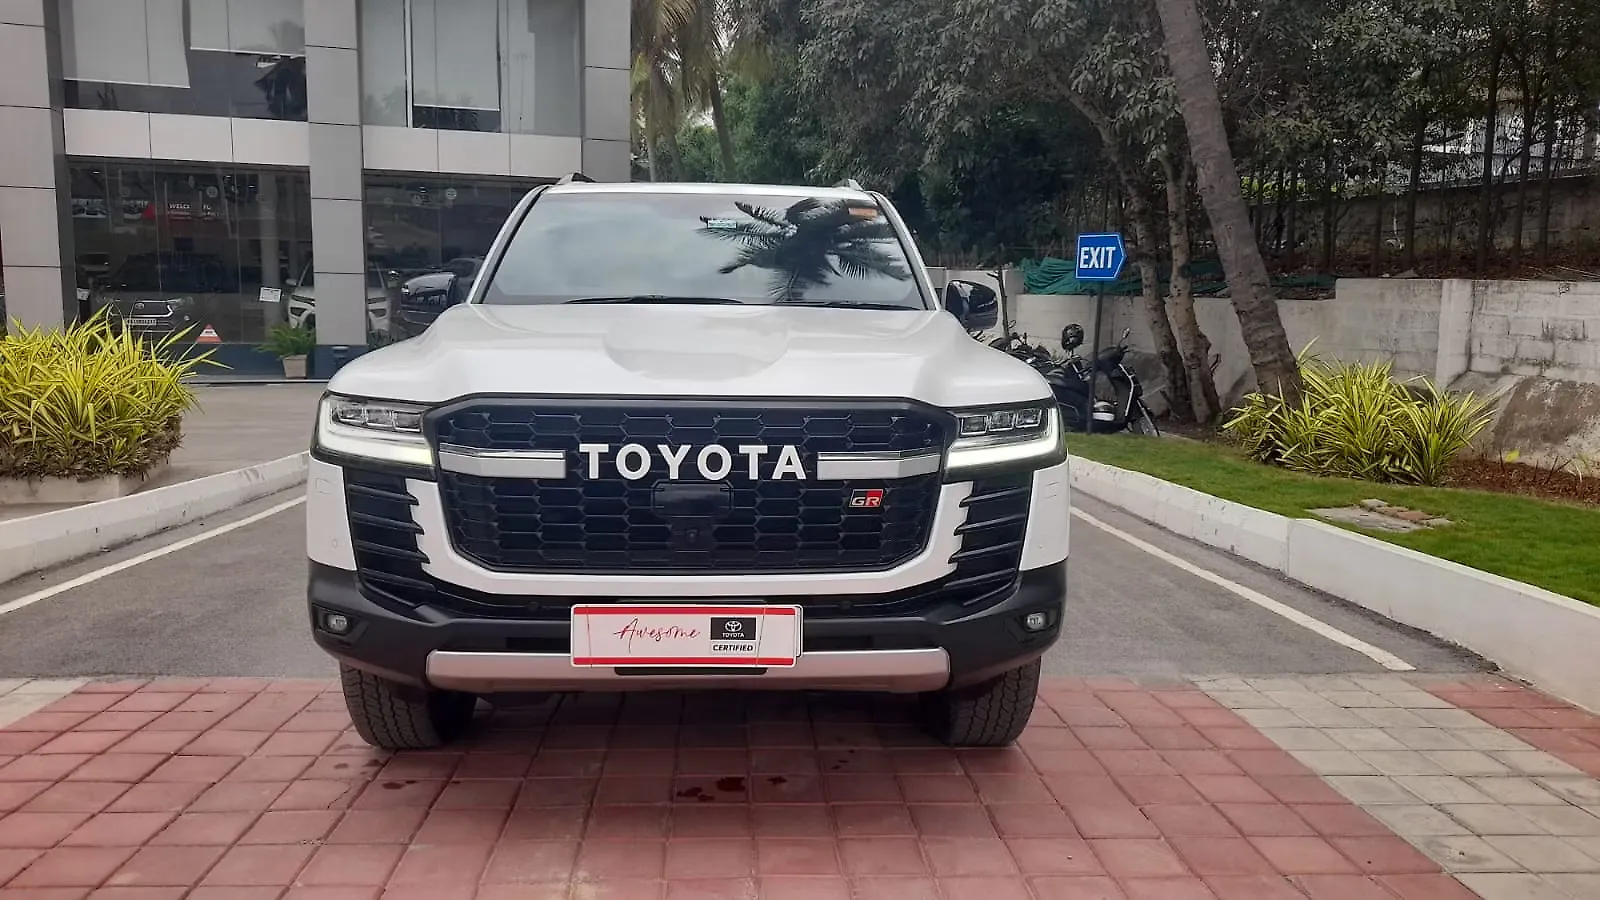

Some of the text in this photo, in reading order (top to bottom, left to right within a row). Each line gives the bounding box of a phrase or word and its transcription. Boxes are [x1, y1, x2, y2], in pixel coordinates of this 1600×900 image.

[1080, 246, 1116, 269] EXIT
[579, 443, 807, 480] TOYOTA
[852, 496, 880, 506] GR
[613, 616, 700, 653] Awesome
[712, 644, 754, 652] CERTIFIED
